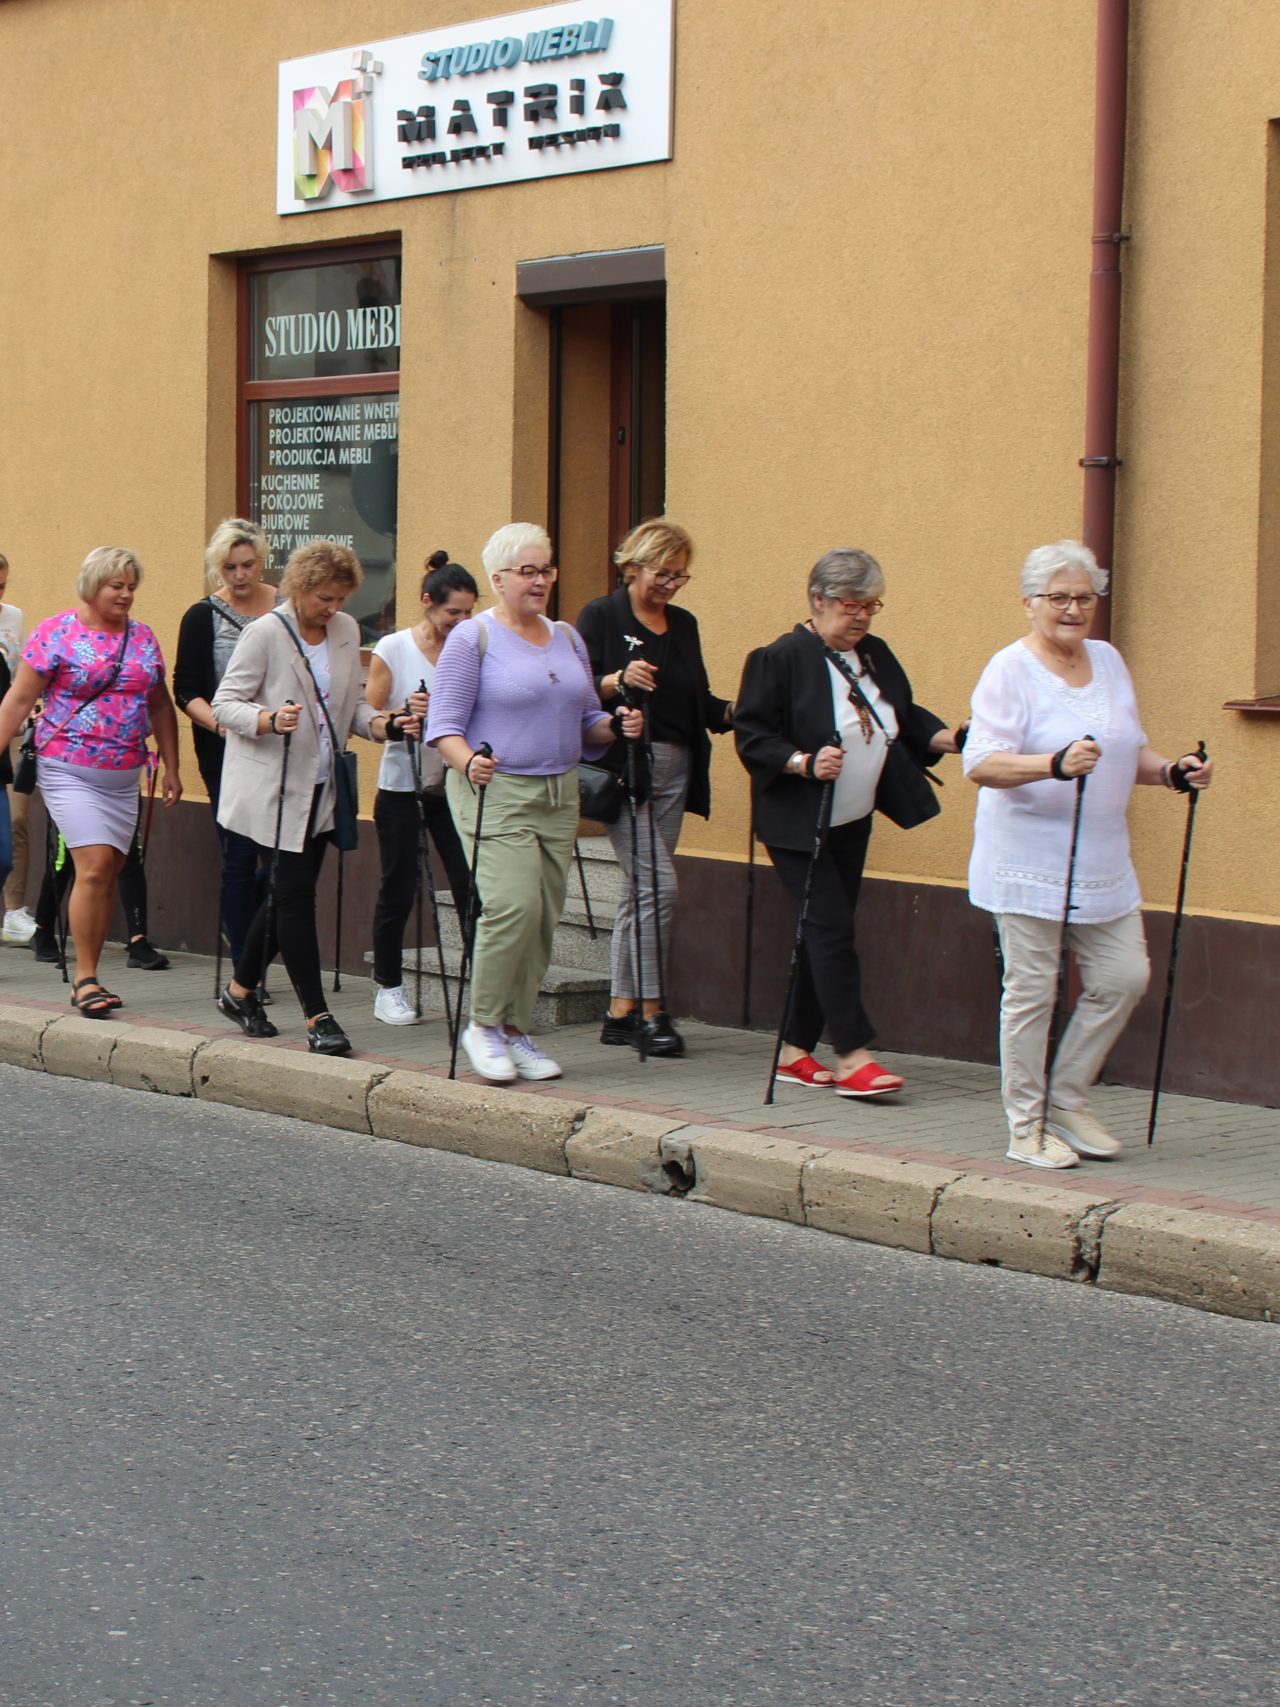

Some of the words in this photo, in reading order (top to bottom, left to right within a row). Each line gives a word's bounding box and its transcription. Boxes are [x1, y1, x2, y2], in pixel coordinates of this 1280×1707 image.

[417, 36, 522, 81] STUDIO
[522, 18, 614, 63] MEBLI
[396, 72, 627, 143] MATRIX
[265, 310, 340, 358] STUDIO
[269, 404, 360, 425] PROJEKTOWANIE
[269, 424, 361, 445] PROJEKTOWANIE
[364, 422, 397, 441] MEBLI
[269, 448, 336, 466] PRODUKCJA
[339, 447, 371, 464] MEBLI
[261, 473, 320, 491] KUCHENNE
[261, 493, 324, 510] POKOJOWE
[261, 514, 309, 531] BIUROWE
[266, 534, 292, 550] ZAFY
